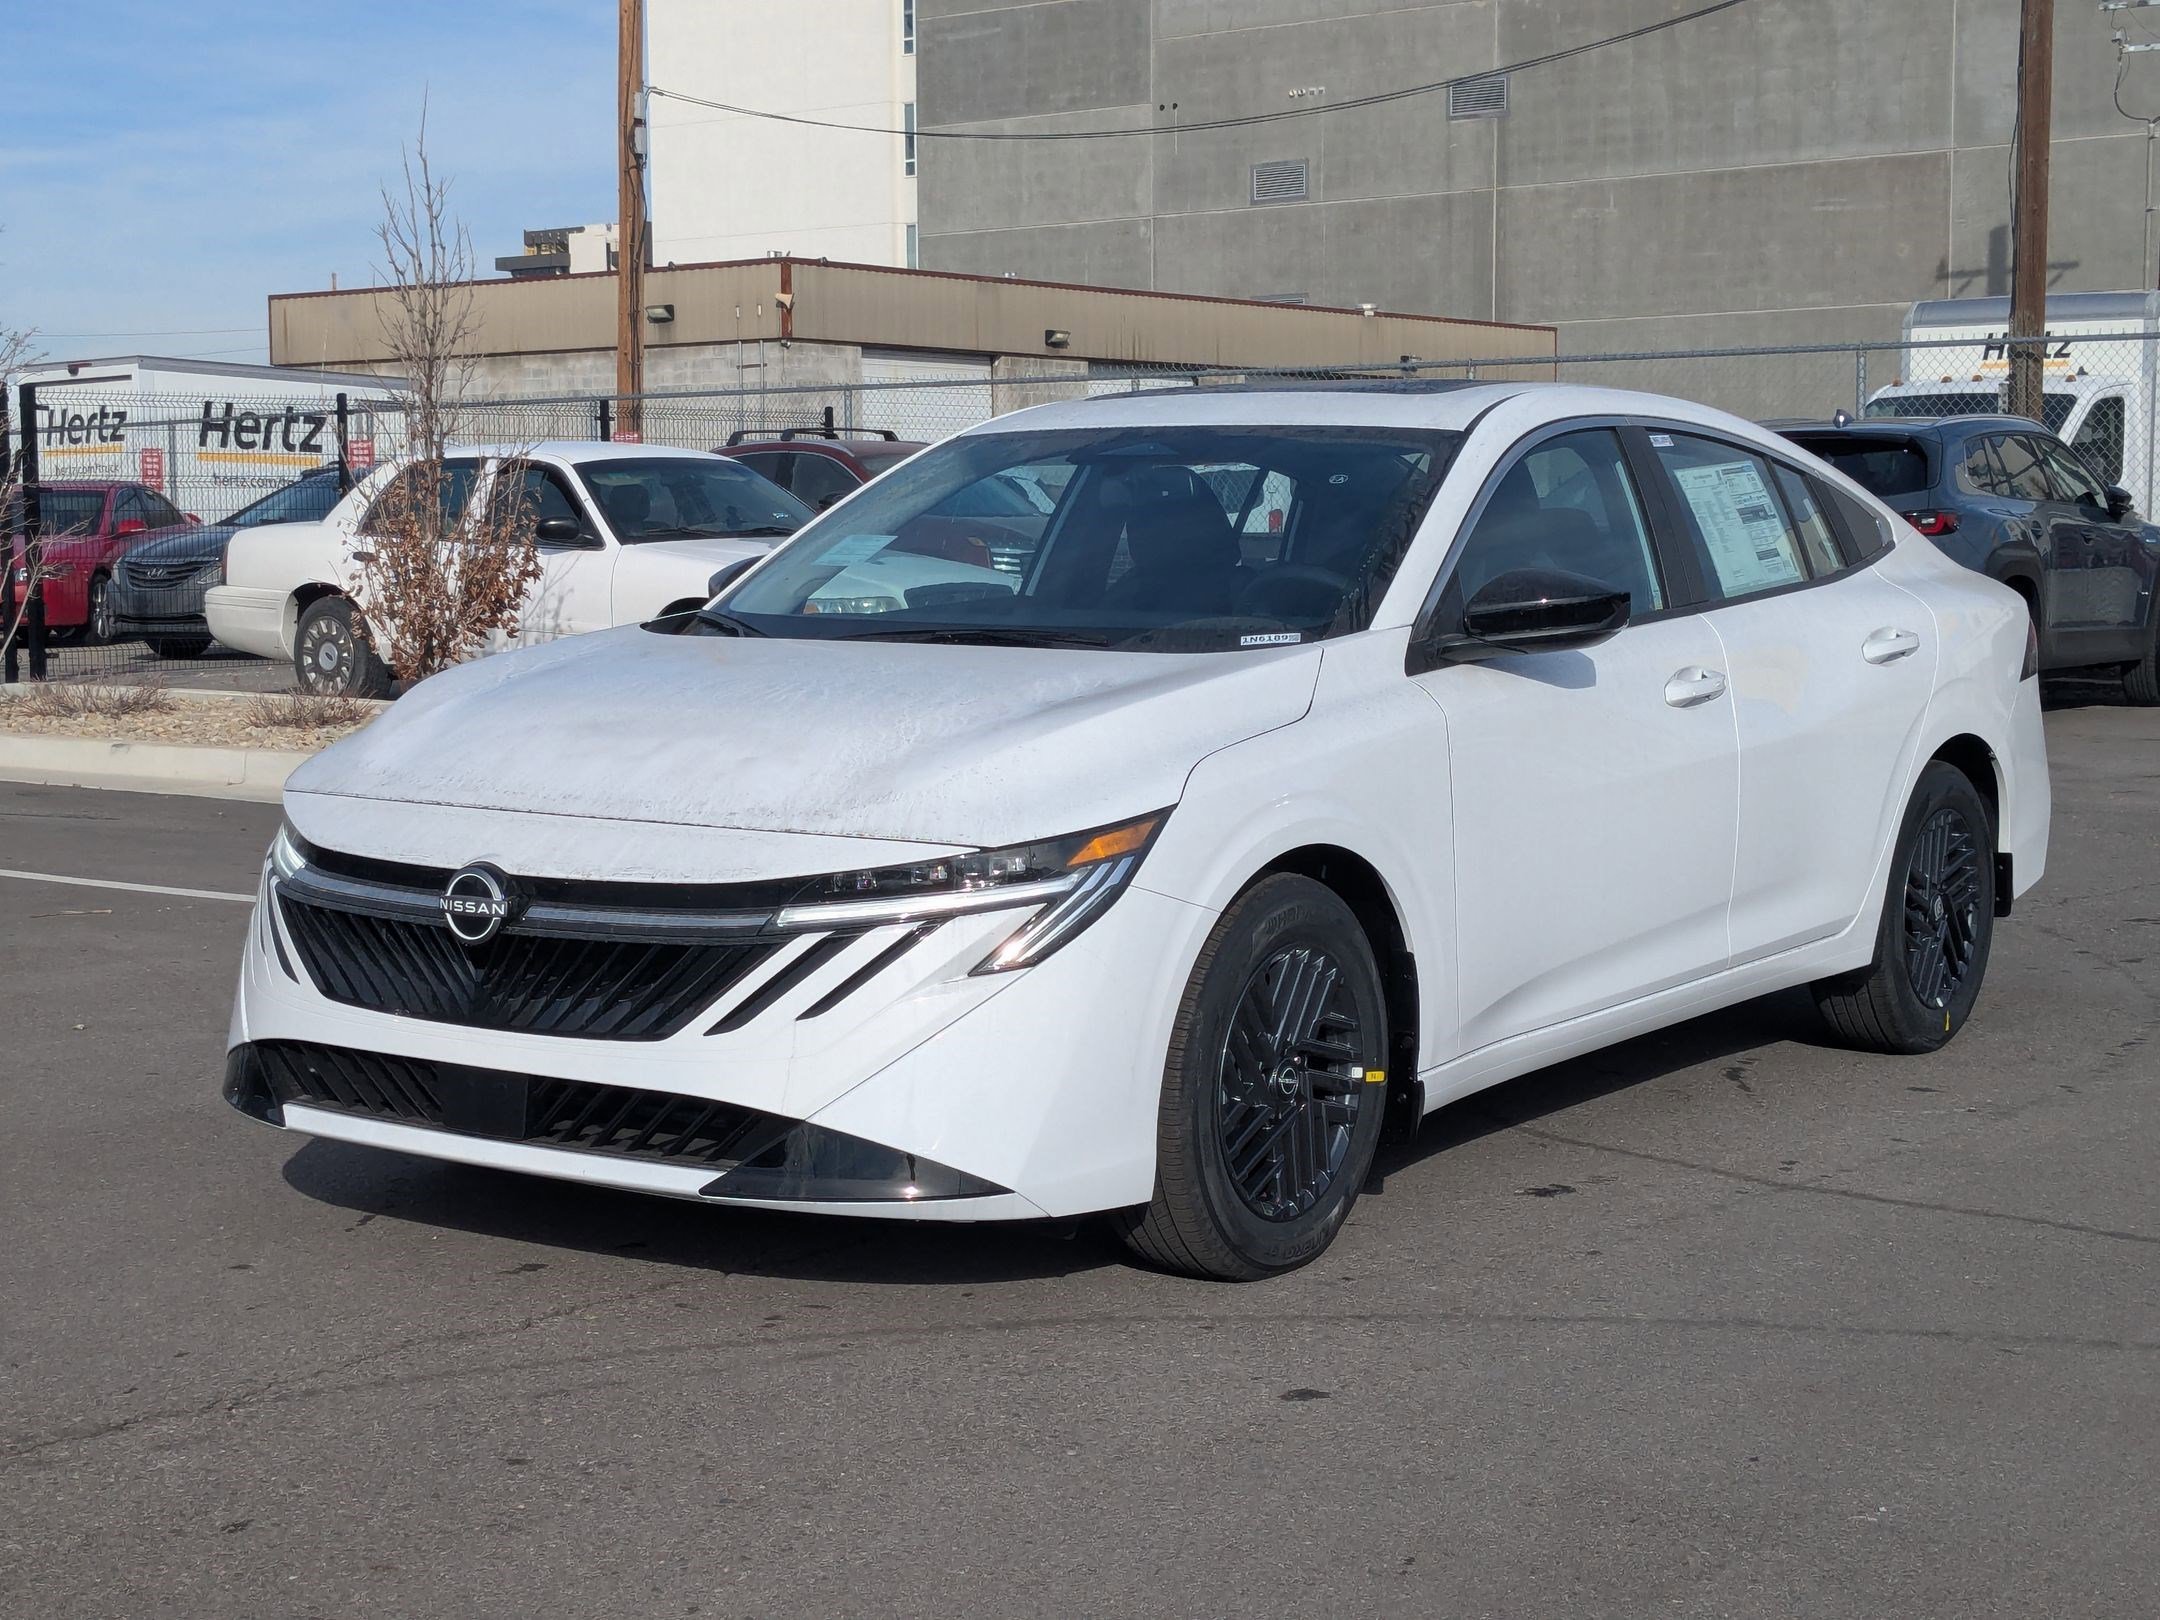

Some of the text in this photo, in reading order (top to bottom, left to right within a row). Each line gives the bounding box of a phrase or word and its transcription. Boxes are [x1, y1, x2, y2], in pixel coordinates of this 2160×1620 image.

[46, 405, 127, 446] Hertz
[199, 400, 327, 453] Hertz
[440, 898, 505, 915] NISSAN
